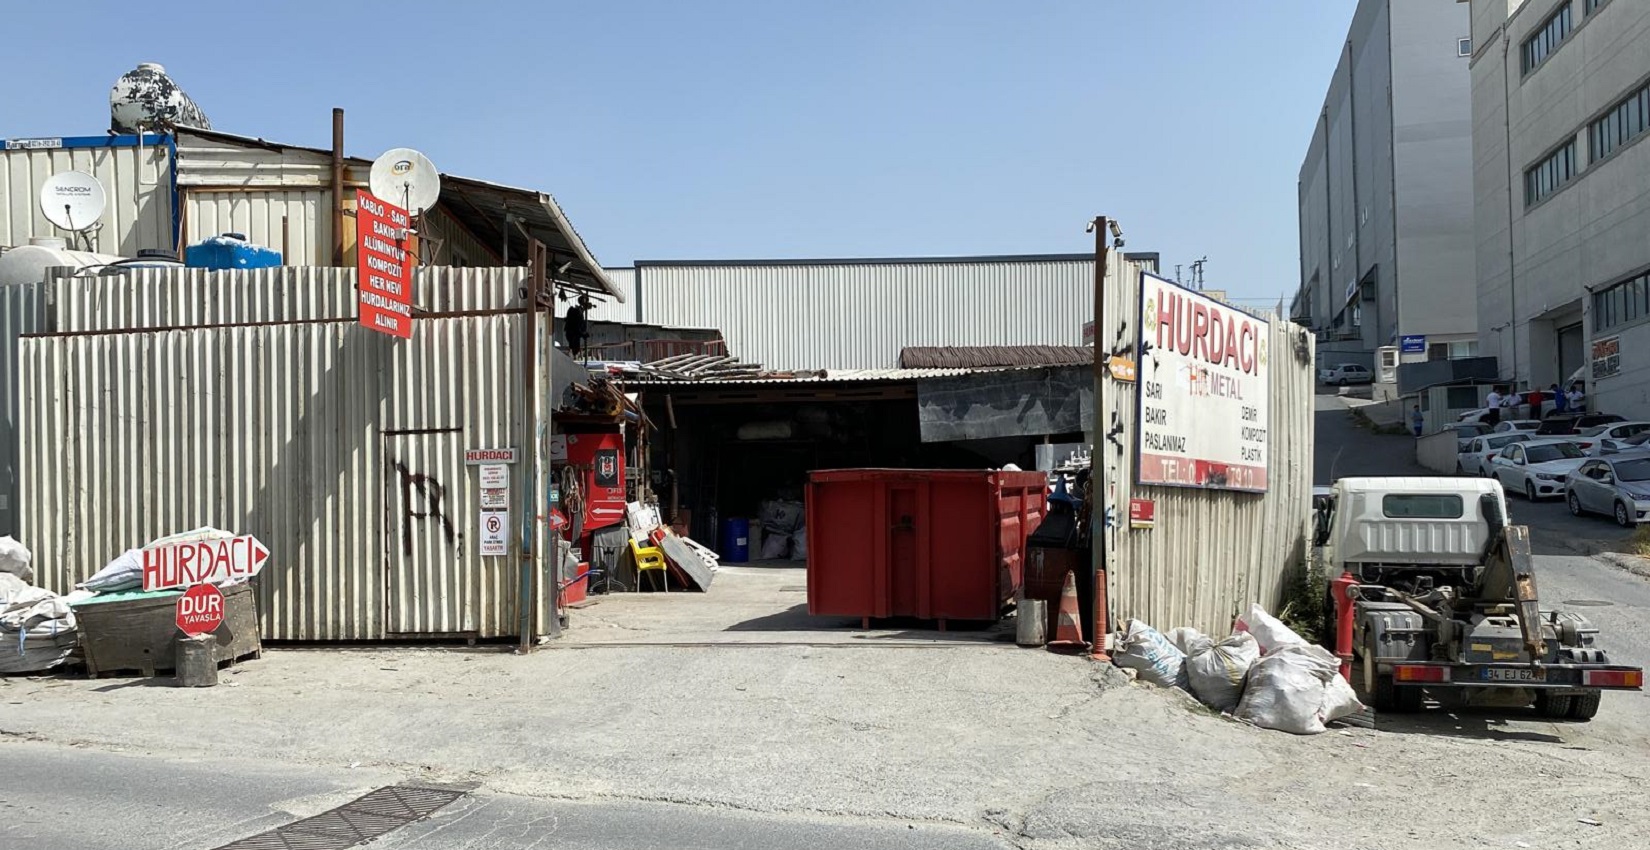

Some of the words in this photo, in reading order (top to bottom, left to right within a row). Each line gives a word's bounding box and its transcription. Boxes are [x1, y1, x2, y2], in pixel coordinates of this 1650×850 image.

[360, 196, 384, 217] KABLO
[373, 220, 396, 239] BAKIR
[367, 254, 402, 278] KOMPOZİT
[369, 275, 385, 291] HER
[375, 313, 398, 331] ALINIR
[1156, 287, 1258, 376] HURDACI
[1145, 381, 1162, 400] SARI
[1211, 372, 1243, 400] METAL
[1145, 406, 1167, 425] BAKIR
[1145, 431, 1186, 453] PASLANMAZ
[466, 451, 513, 460] HURDACI
[143, 536, 253, 591] HURDACI
[181, 594, 221, 615] DUR
[184, 613, 221, 624] YAVAŞLA
[1488, 669, 1499, 679] 34
[1505, 669, 1516, 680] EJ
